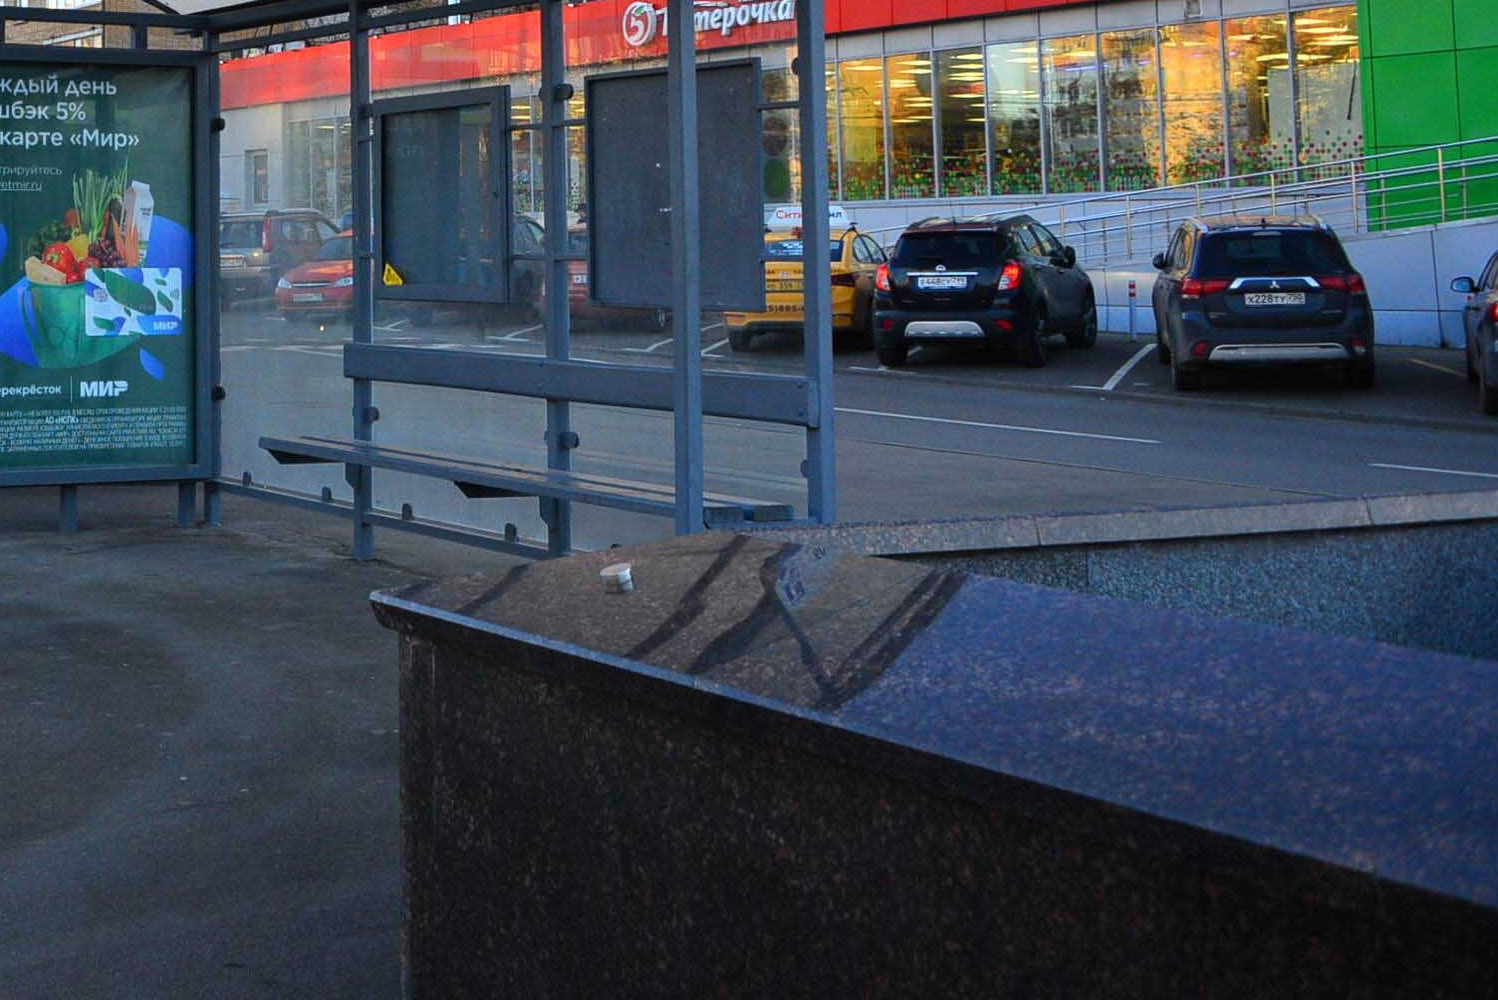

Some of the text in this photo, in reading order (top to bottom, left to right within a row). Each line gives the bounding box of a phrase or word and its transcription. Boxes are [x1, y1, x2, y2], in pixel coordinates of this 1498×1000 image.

[655, 0, 795, 37] терочка
[65, 79, 118, 97] день
[56, 102, 87, 121] 5%
[0, 132, 64, 150] карте
[69, 128, 140, 150] «Мир»
[775, 209, 843, 220] Ситиил
[79, 380, 129, 398] МИР
